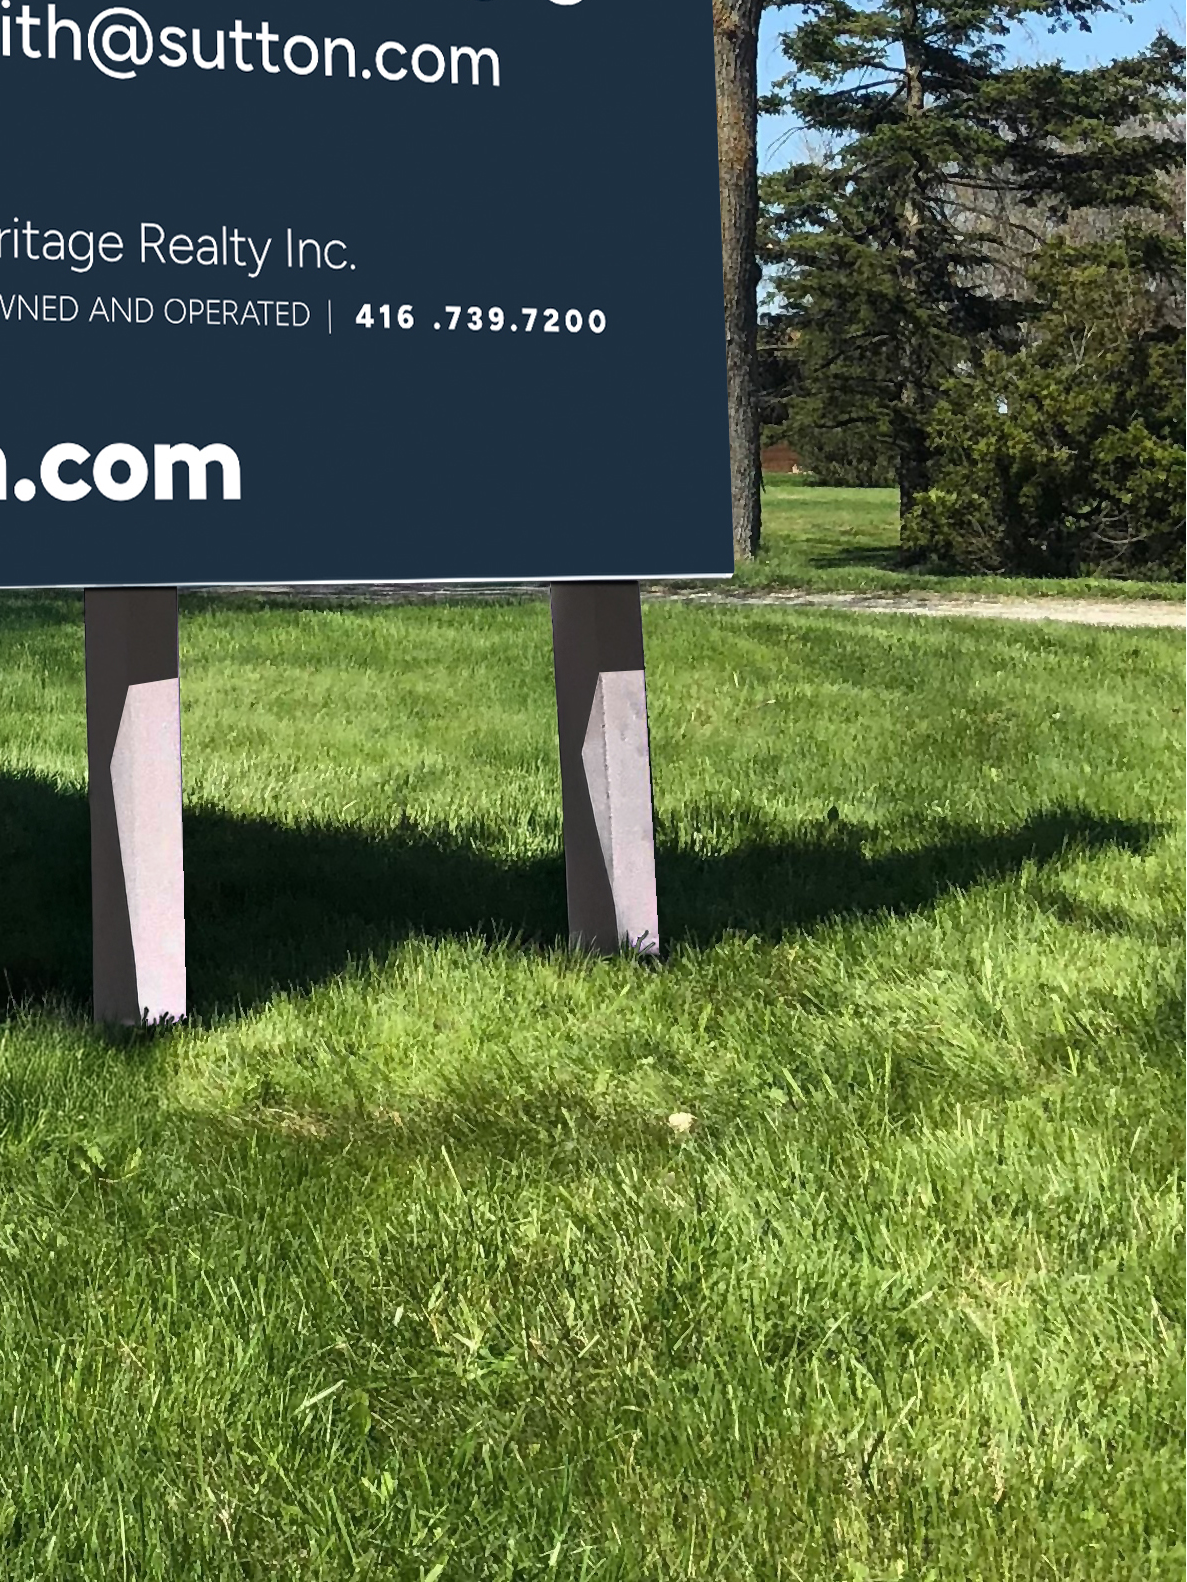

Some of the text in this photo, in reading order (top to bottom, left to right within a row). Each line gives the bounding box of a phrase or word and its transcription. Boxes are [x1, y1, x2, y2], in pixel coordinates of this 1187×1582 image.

[140, 222, 273, 279] Realty
[287, 227, 356, 271] Inc.
[88, 296, 154, 324] AND
[163, 298, 311, 327] OPERATED
[355, 303, 415, 330] 416
[433, 305, 607, 334] .739.7200
